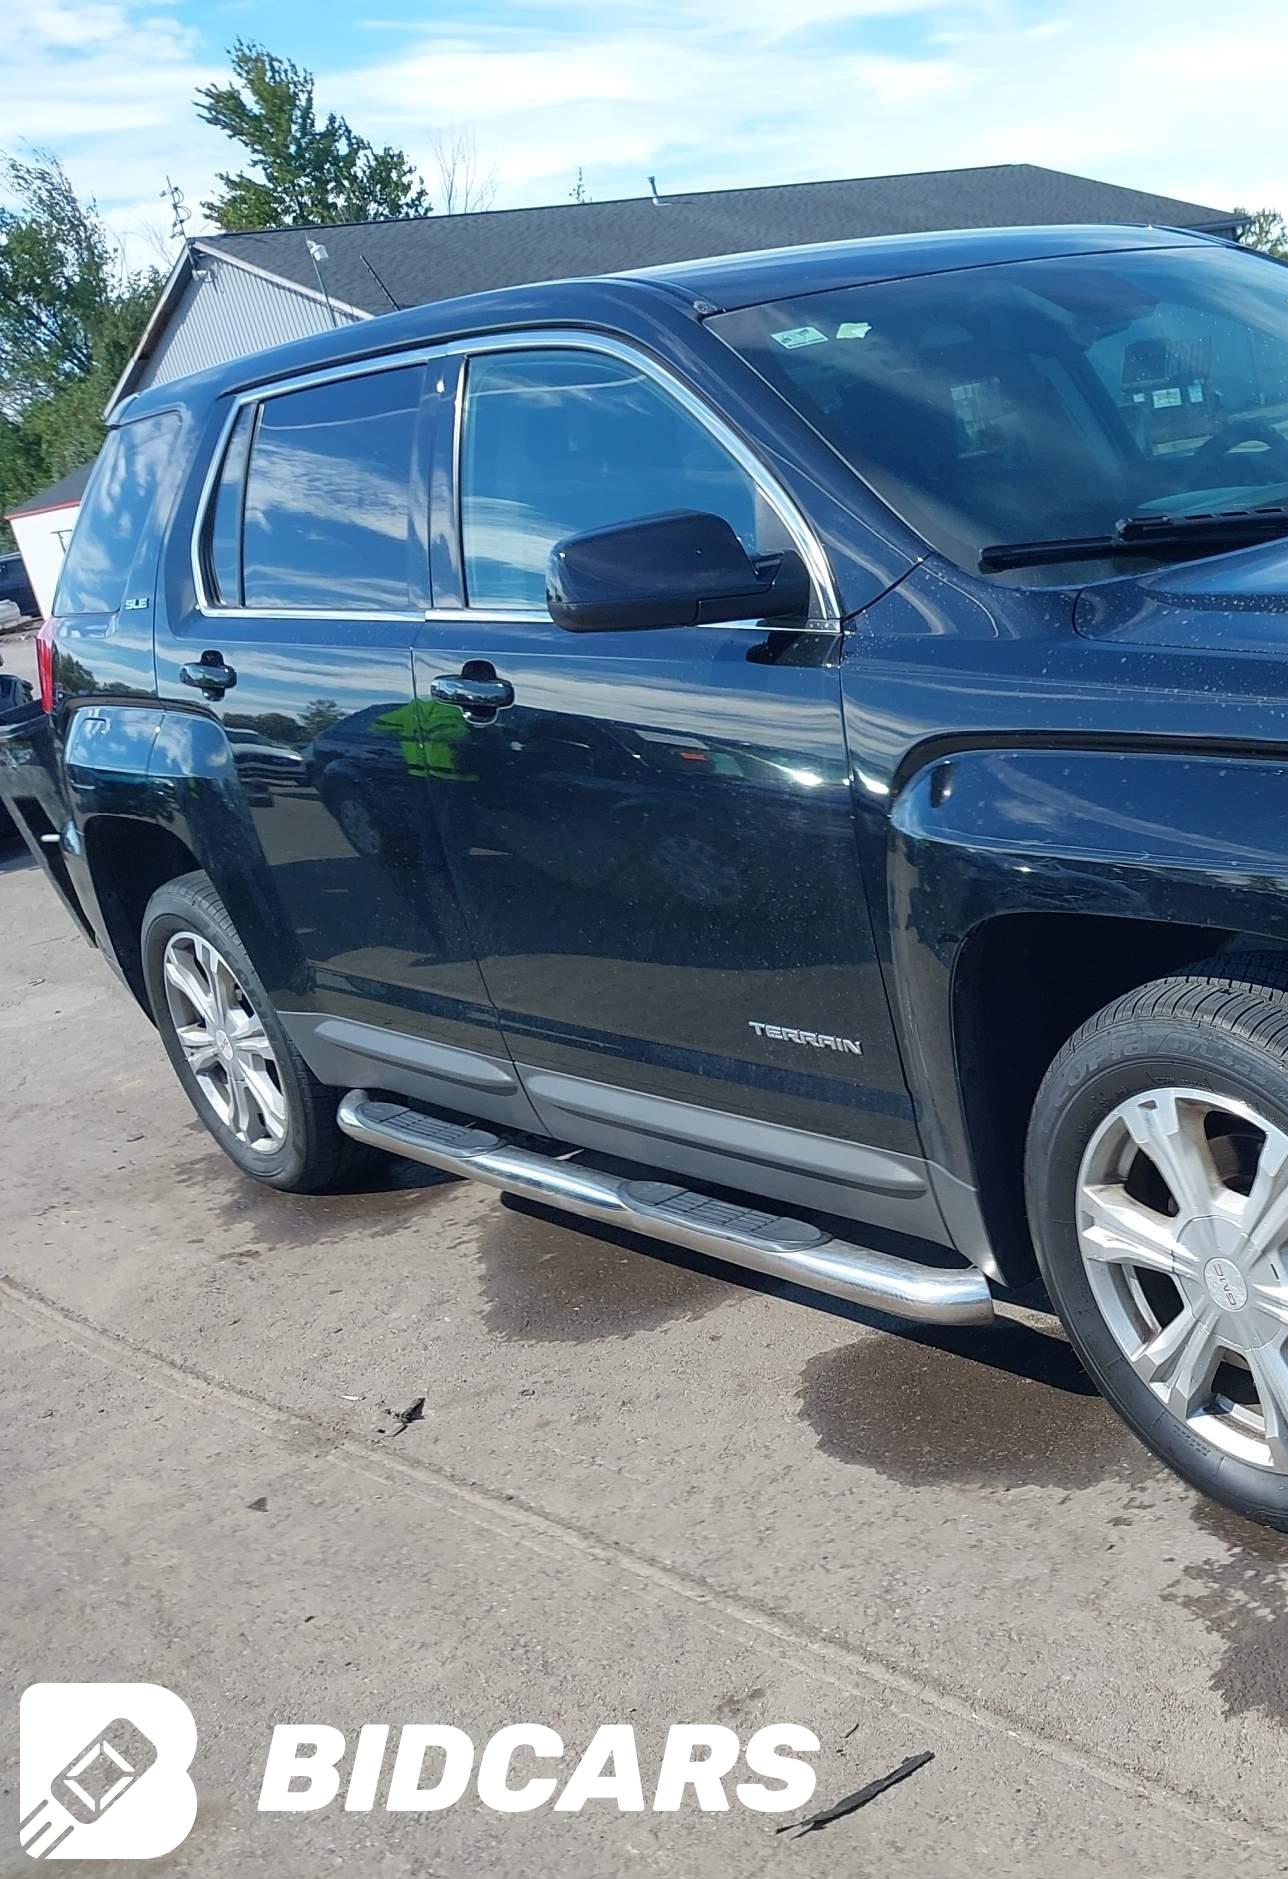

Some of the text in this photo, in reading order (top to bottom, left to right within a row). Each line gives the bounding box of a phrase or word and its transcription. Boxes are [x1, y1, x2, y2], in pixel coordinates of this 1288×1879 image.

[124, 597, 149, 610] SLE
[748, 1021, 864, 1056] TERRAIN
[1213, 1263, 1237, 1306] GMC
